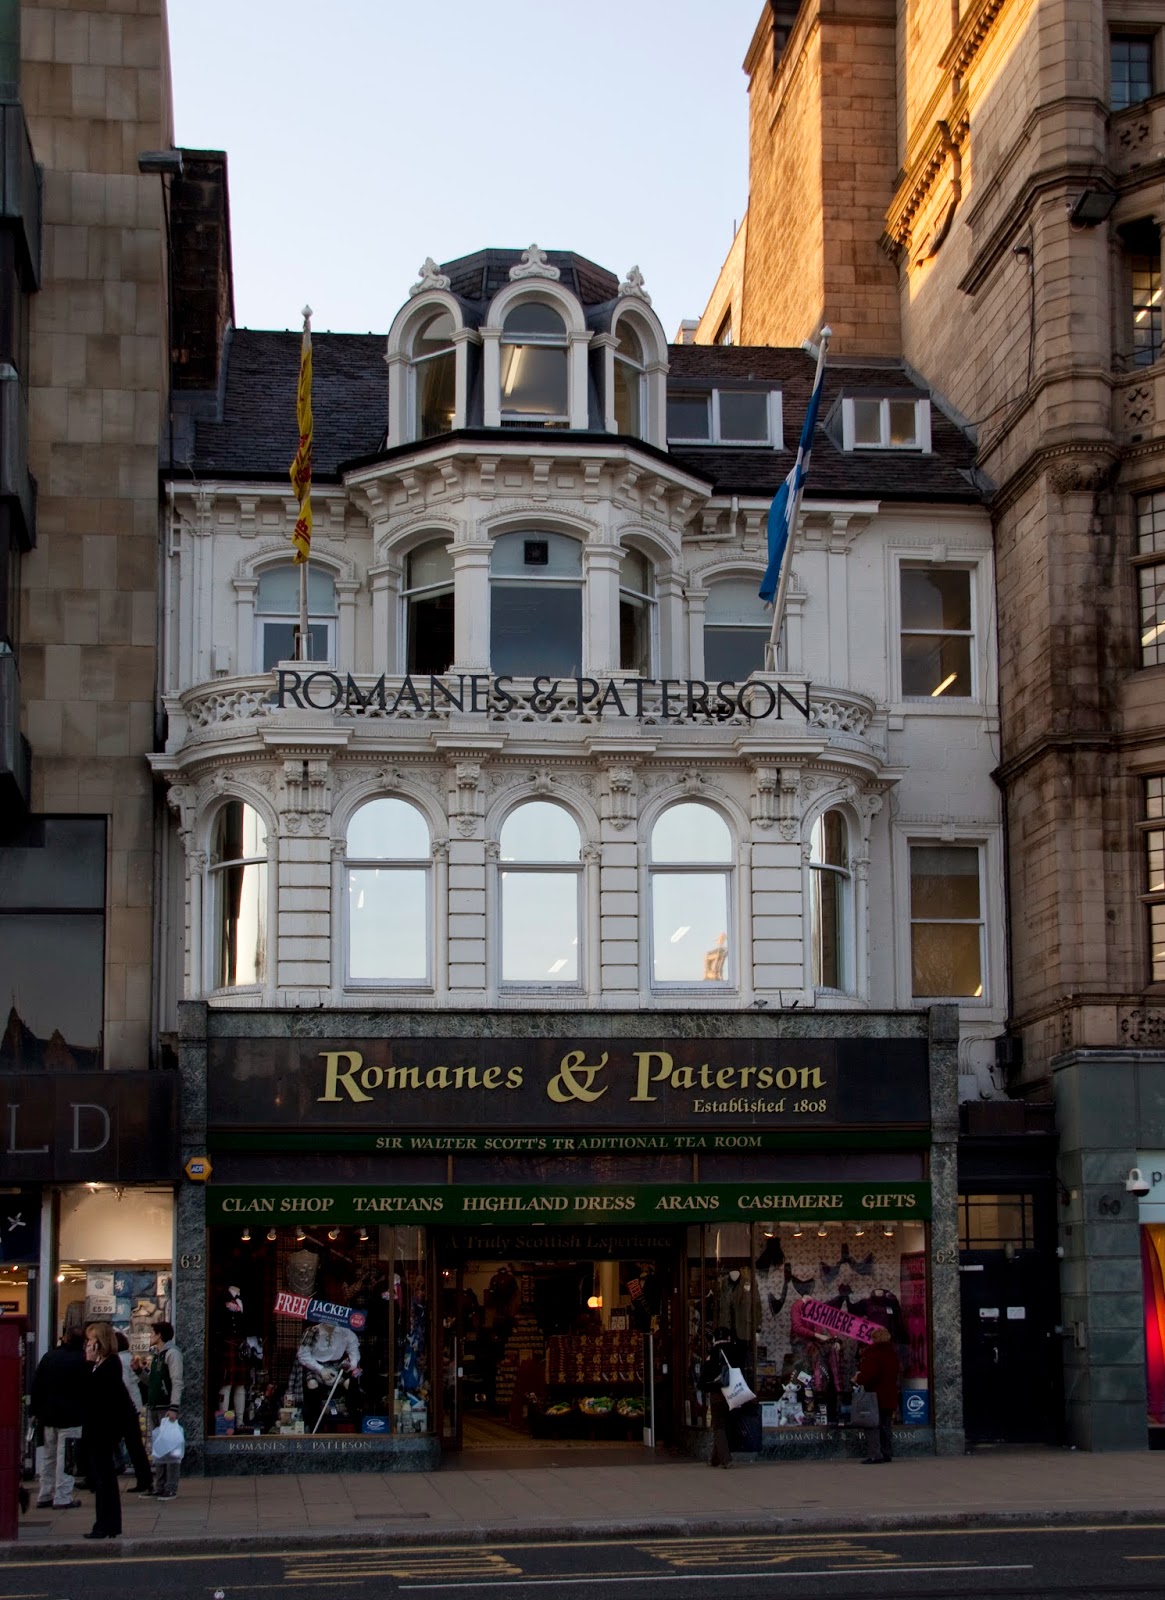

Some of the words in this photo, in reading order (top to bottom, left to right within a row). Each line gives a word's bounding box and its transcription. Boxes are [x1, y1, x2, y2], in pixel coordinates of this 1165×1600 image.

[276, 669, 513, 714] ROMANES
[530, 675, 561, 715] &
[574, 677, 813, 721] PATERSON
[317, 1050, 523, 1103] Romanes
[547, 1050, 609, 1103] &
[629, 1050, 827, 1103] Paterson
[693, 1098, 785, 1114] Established
[793, 1099, 827, 1114] 1808
[376, 1136, 403, 1150] SIR
[410, 1137, 478, 1150] WALTER
[484, 1136, 548, 1150] SCOTT'S
[553, 1136, 669, 1150] TRADITIONAL
[674, 1135, 707, 1149] TEA
[714, 1135, 763, 1149] ROOM
[191, 1164, 204, 1173] ADT
[222, 1197, 276, 1213] CLAN
[280, 1197, 335, 1213] SHOP
[353, 1197, 444, 1213] TARTANS
[462, 1196, 570, 1213] HIGHLAND
[574, 1195, 636, 1211] DRESS
[654, 1195, 720, 1211] ARANS
[737, 1194, 844, 1210] CASHMERE
[861, 1193, 917, 1210] GIFTS
[181, 1254, 201, 1268] 62
[936, 1249, 957, 1264] 62
[275, 1292, 309, 1317] FREE
[310, 1300, 353, 1319] JACKET
[802, 1301, 856, 1334] CASHMERE
[779, 1431, 833, 1441] ROMANES
[229, 1442, 286, 1451] ROMANES
[312, 1441, 372, 1450] PATERSON
